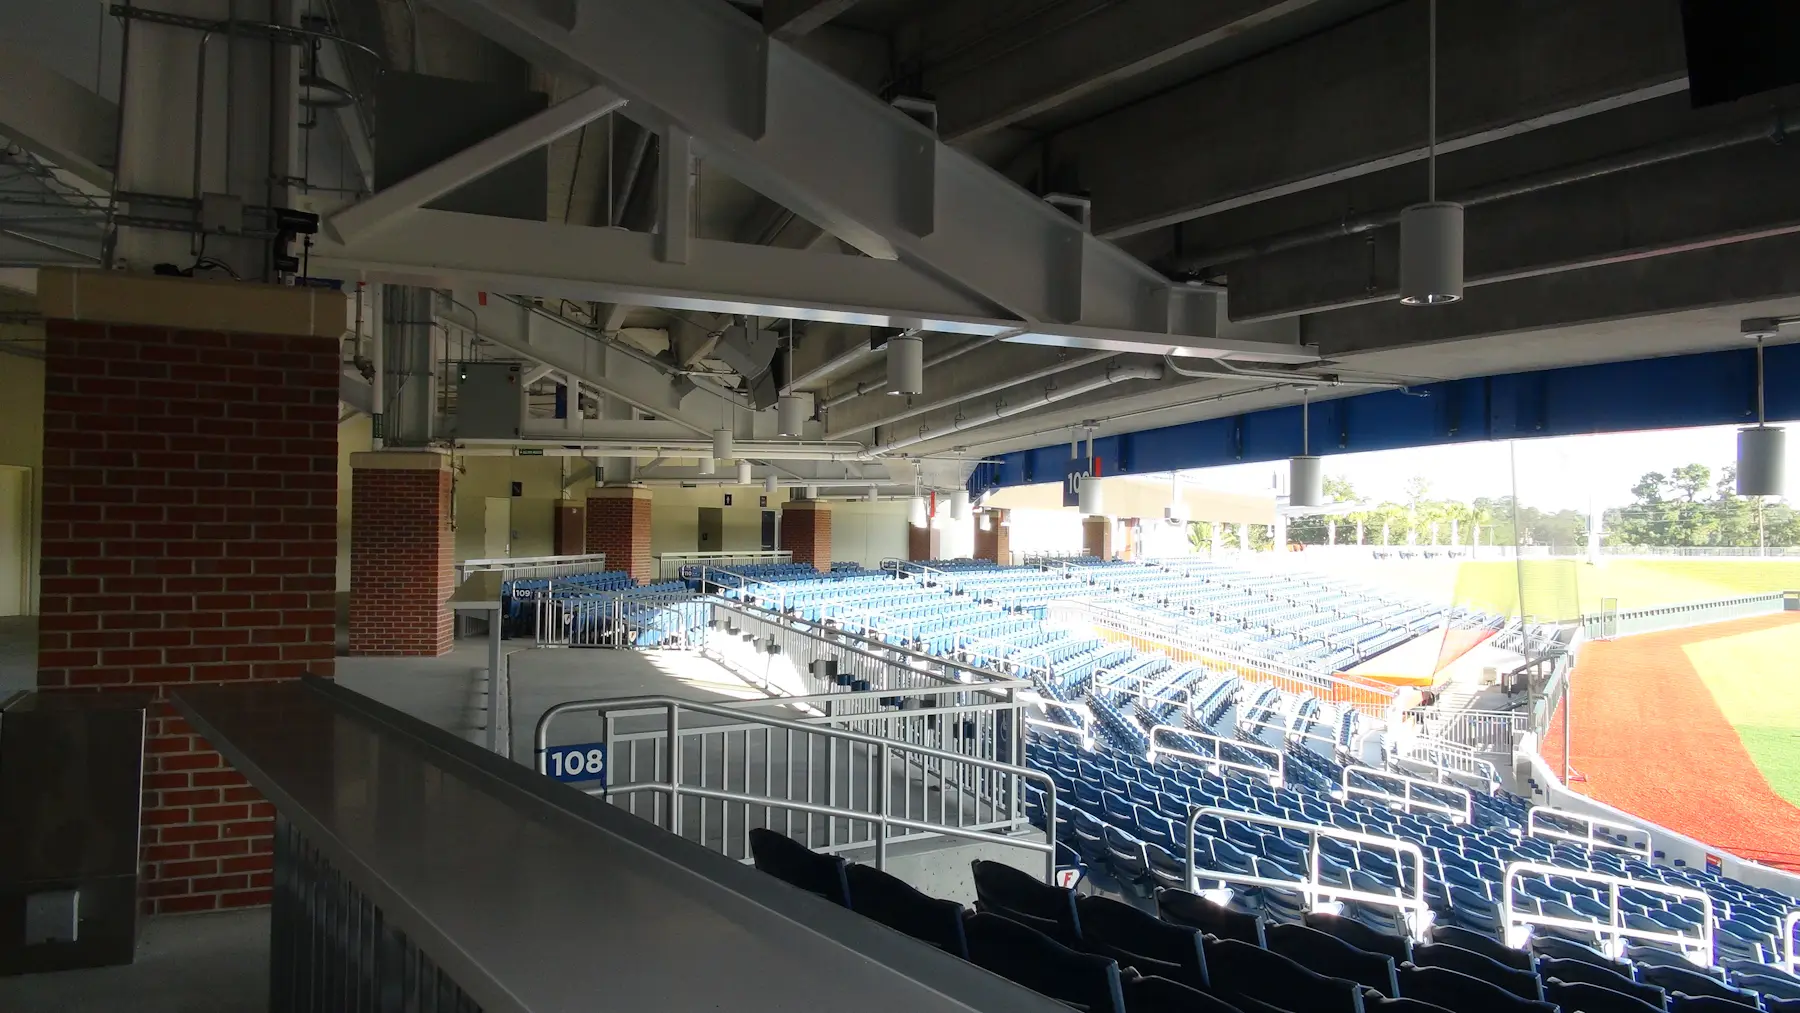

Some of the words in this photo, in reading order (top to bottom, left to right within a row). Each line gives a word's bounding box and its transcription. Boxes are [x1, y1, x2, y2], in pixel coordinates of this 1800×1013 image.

[1067, 471, 1090, 494] 10
[551, 749, 603, 776] 108
[1064, 871, 1073, 887] F
